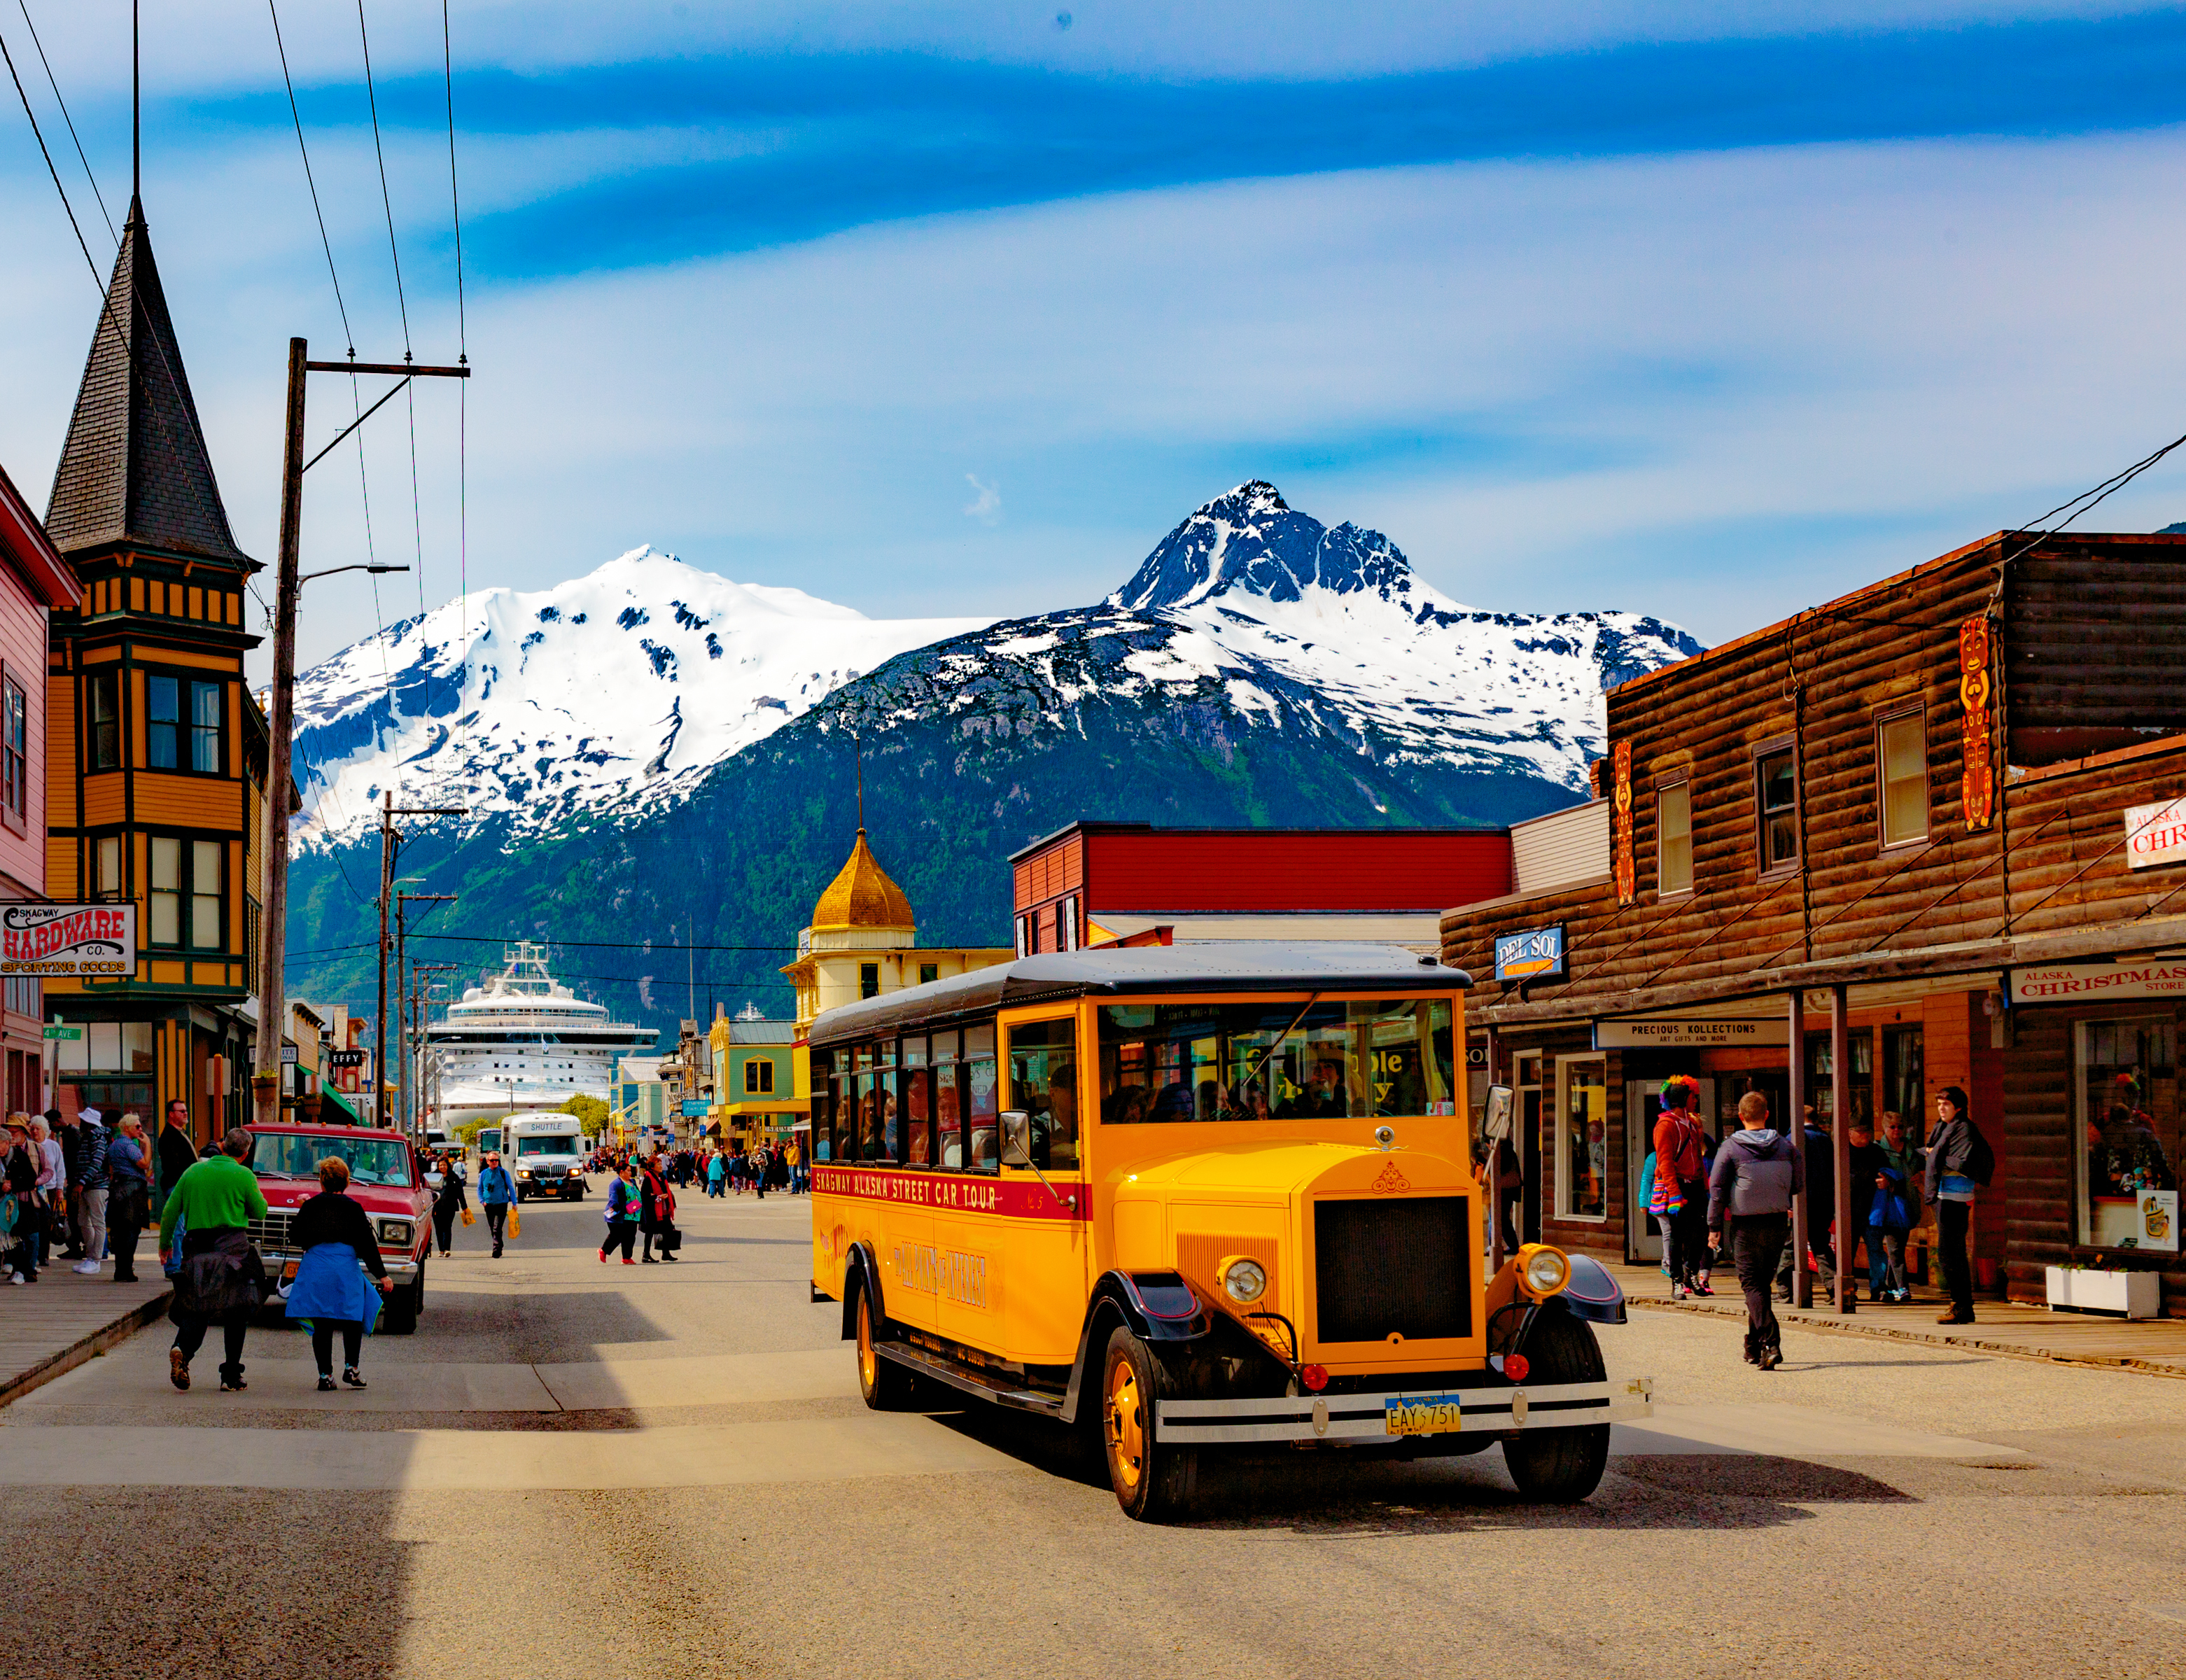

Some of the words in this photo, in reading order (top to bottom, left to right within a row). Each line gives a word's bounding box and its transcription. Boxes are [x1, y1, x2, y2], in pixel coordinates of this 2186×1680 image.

[2136, 809, 2182, 828] ALASKA
[20, 909, 59, 918] SKAGWAY
[3, 910, 125, 960] HARDWARE
[87, 946, 105, 955] CO.
[1499, 937, 1527, 970] DEL
[1531, 934, 1560, 960] SOL
[1, 961, 76, 972] SPORTING
[80, 961, 126, 972] GOODS
[2020, 967, 2186, 997] CHRISTMAS
[2025, 971, 2073, 981] ALASKA
[2145, 981, 2185, 990] STORE
[58, 1030, 71, 1038] AVE
[1632, 1025, 1679, 1034] PRECIOUS
[1688, 1024, 1756, 1034] KOLLECTIONS
[333, 1054, 359, 1063] EFFY
[816, 1172, 850, 1192] SKAGWAY
[854, 1175, 888, 1198] ALASKA
[892, 1179, 930, 1203] STREET
[935, 1182, 957, 1205] CAR
[963, 1184, 995, 1210] TOUR
[1037, 1196, 1044, 1209] 5
[946, 1250, 986, 1308] INTEREST
[1390, 1408, 1417, 1427] EAY
[1429, 1406, 1455, 1425] 751
